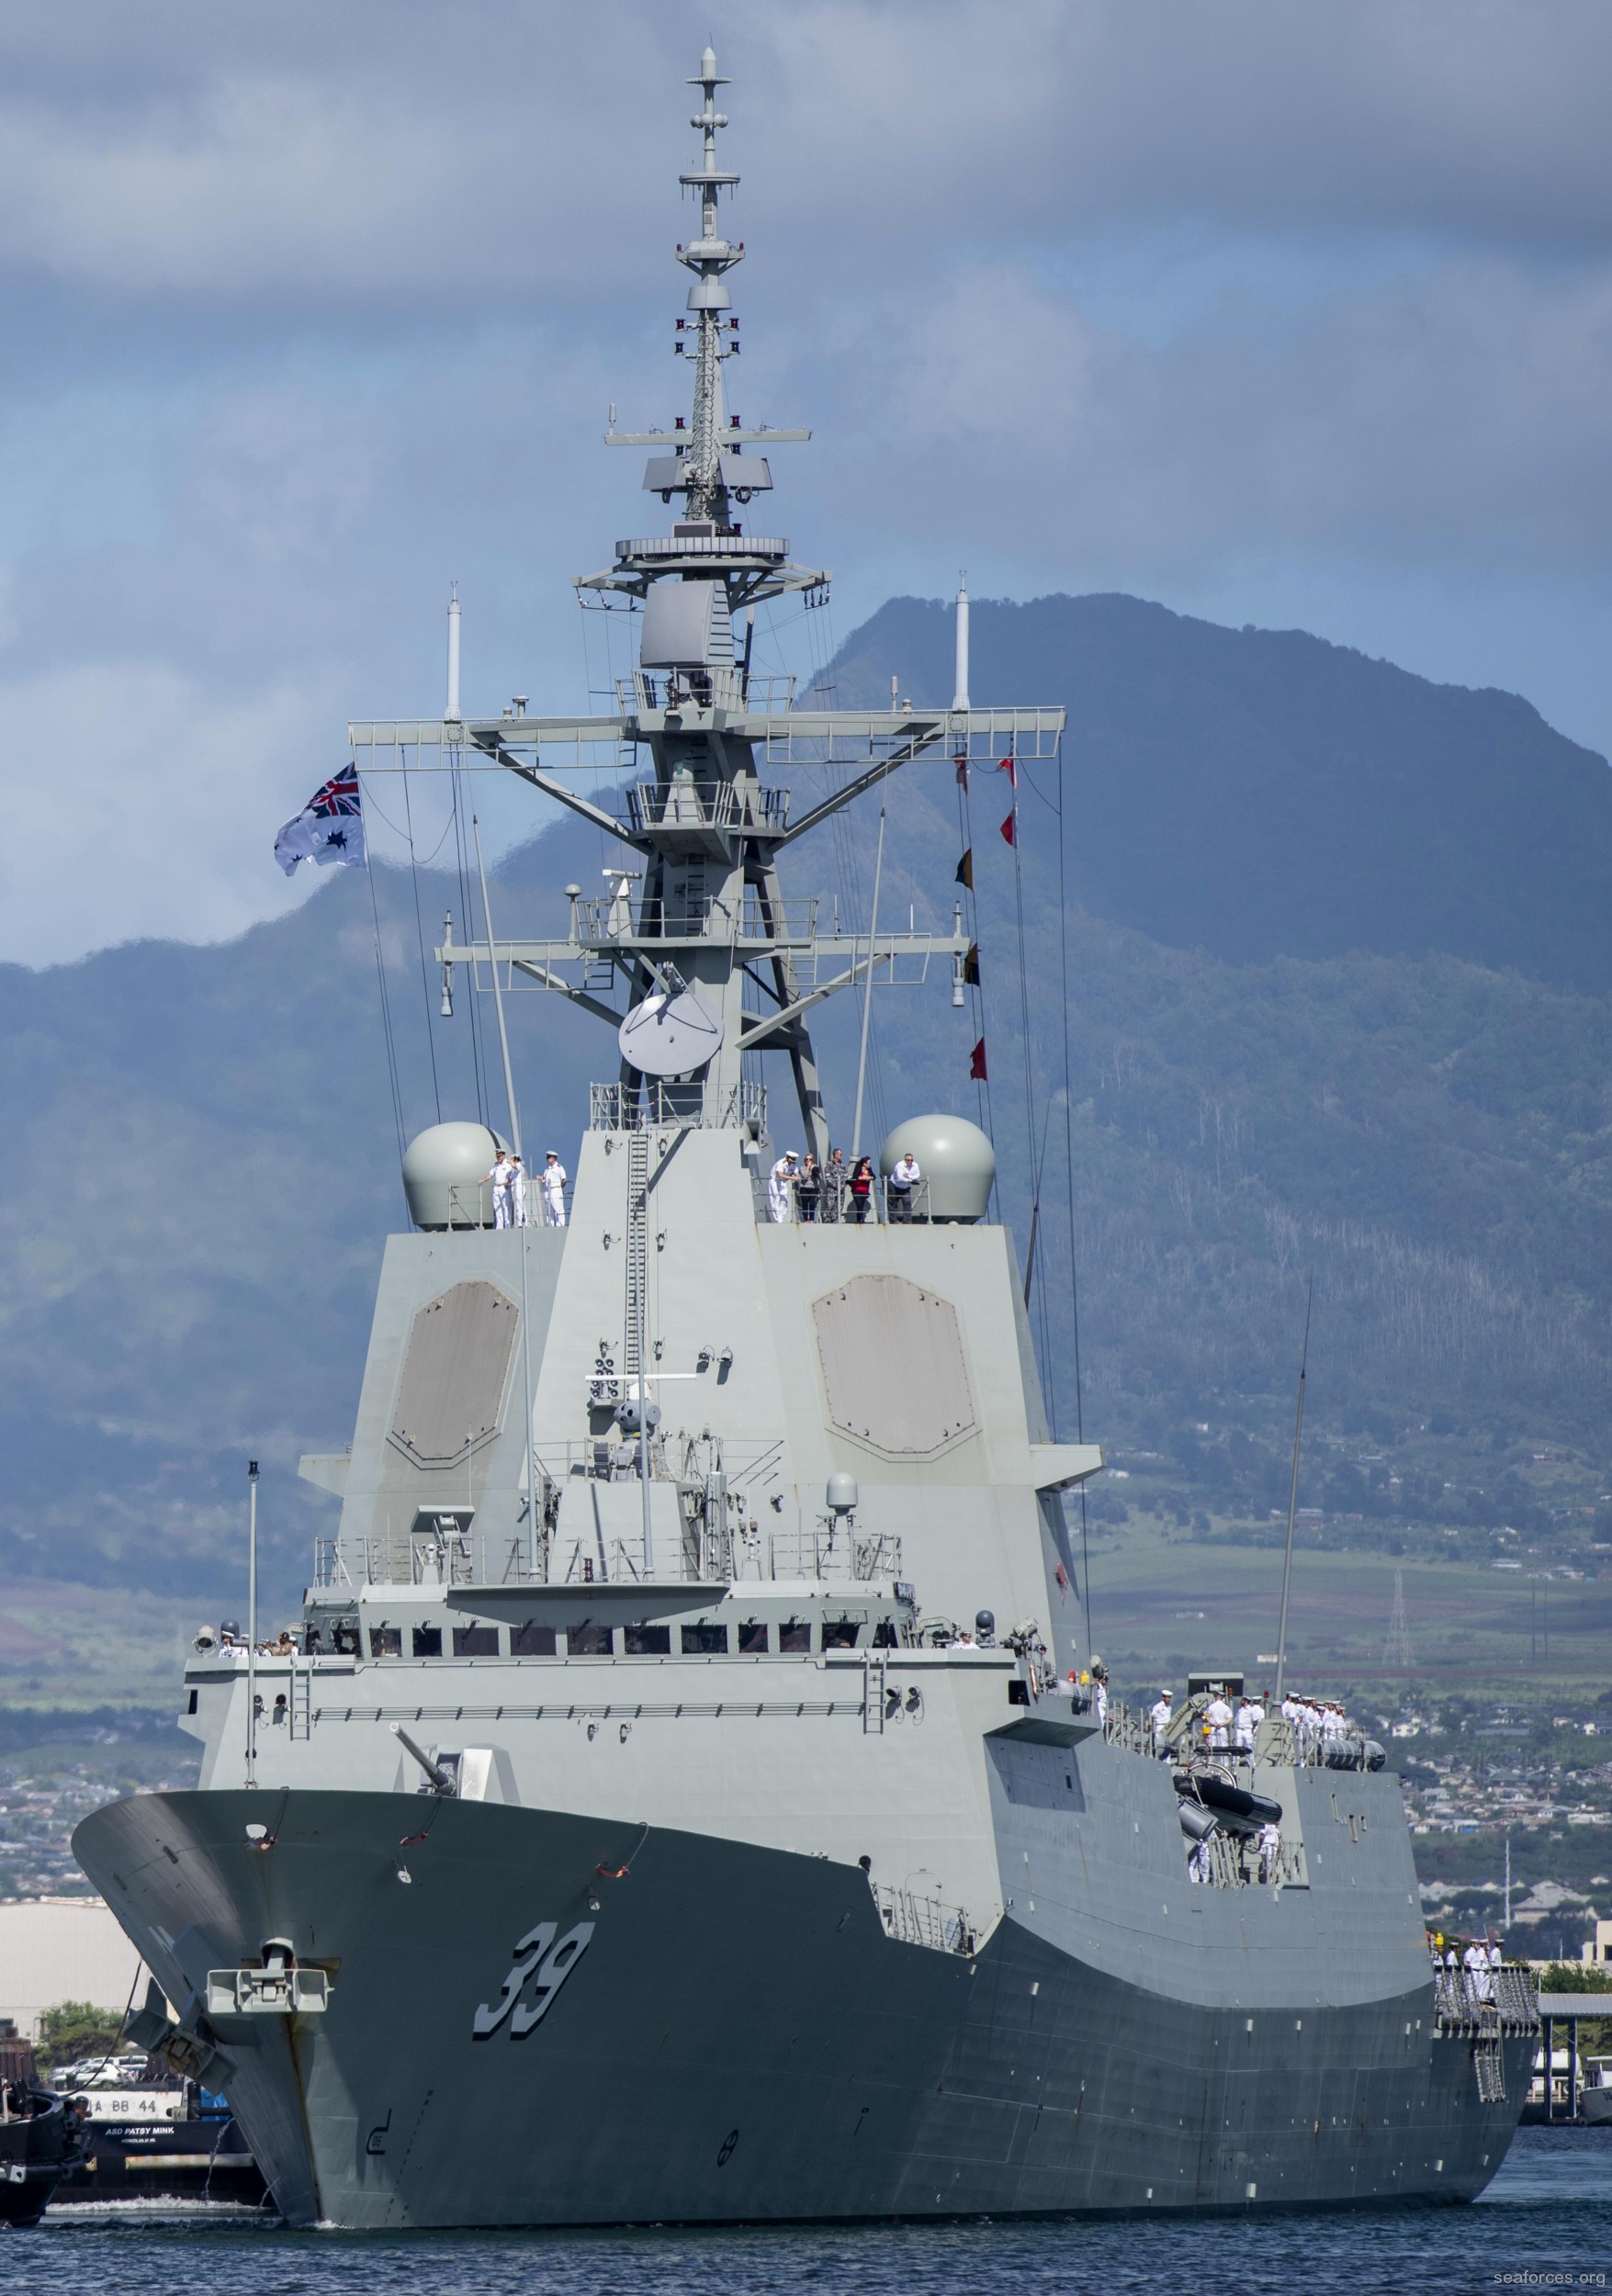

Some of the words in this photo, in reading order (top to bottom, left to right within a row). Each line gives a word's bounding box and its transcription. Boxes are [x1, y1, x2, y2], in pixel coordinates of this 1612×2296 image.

[472, 1921, 596, 2041] 39
[112, 2100, 129, 2111] BB
[139, 2100, 155, 2111] 44
